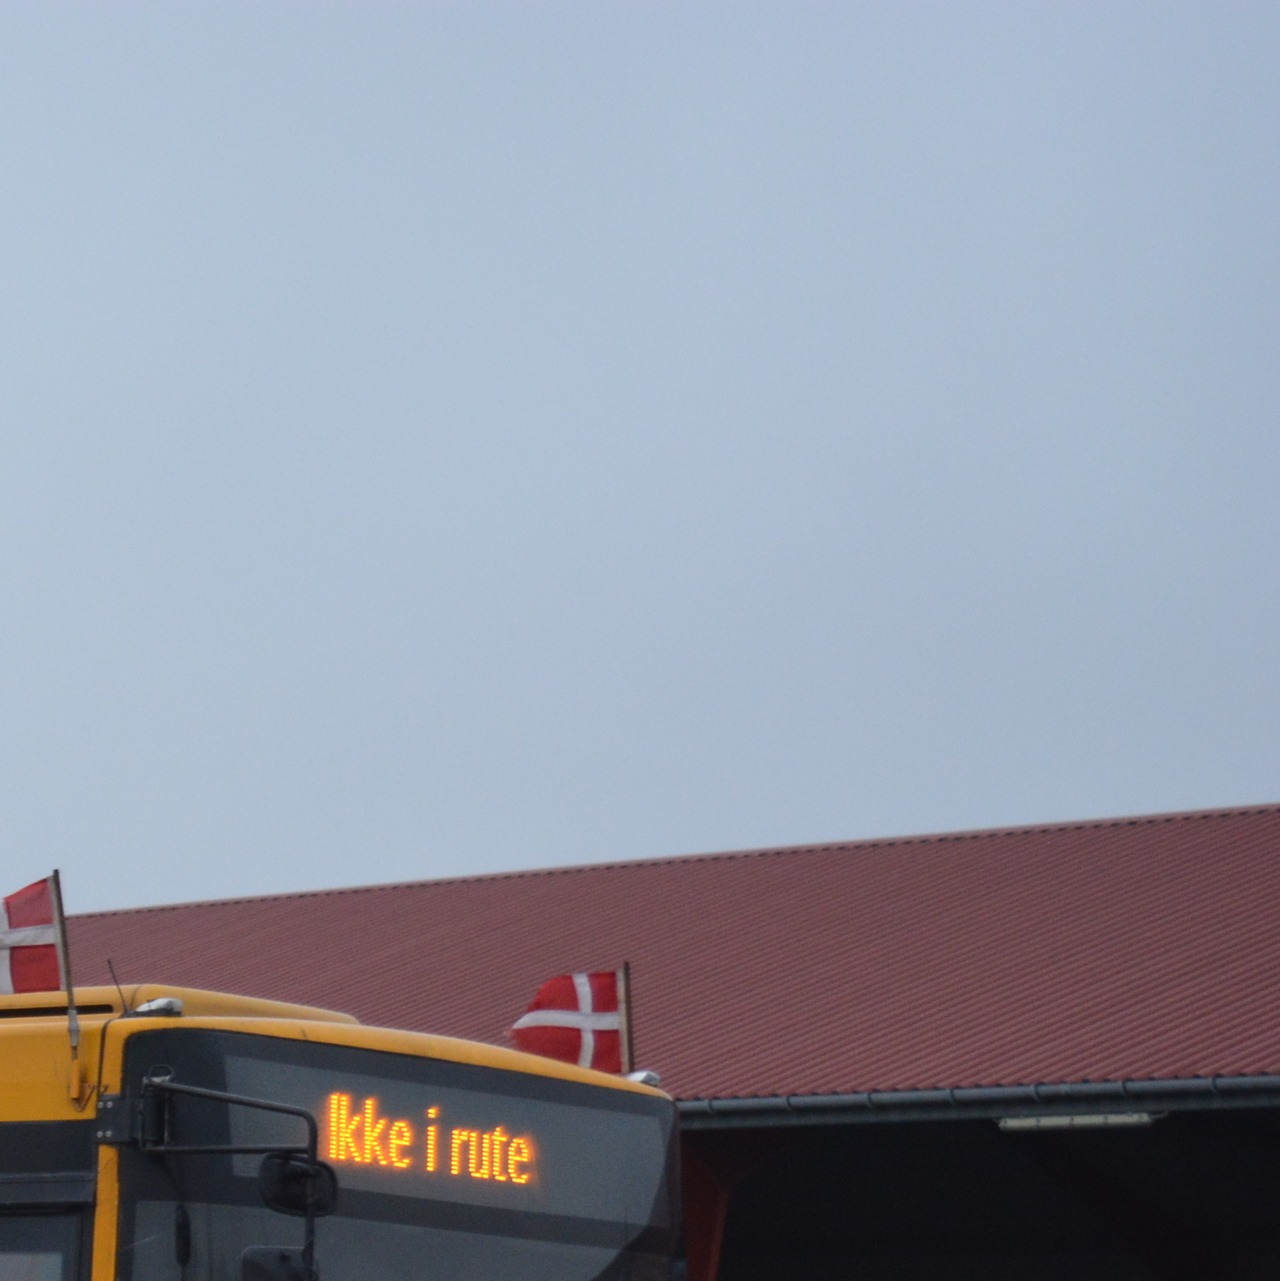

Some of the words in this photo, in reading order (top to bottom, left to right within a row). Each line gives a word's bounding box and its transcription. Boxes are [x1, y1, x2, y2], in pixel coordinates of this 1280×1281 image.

[328, 1093, 411, 1168] Ikke
[425, 1107, 438, 1172] i
[450, 1126, 529, 1184] rute
